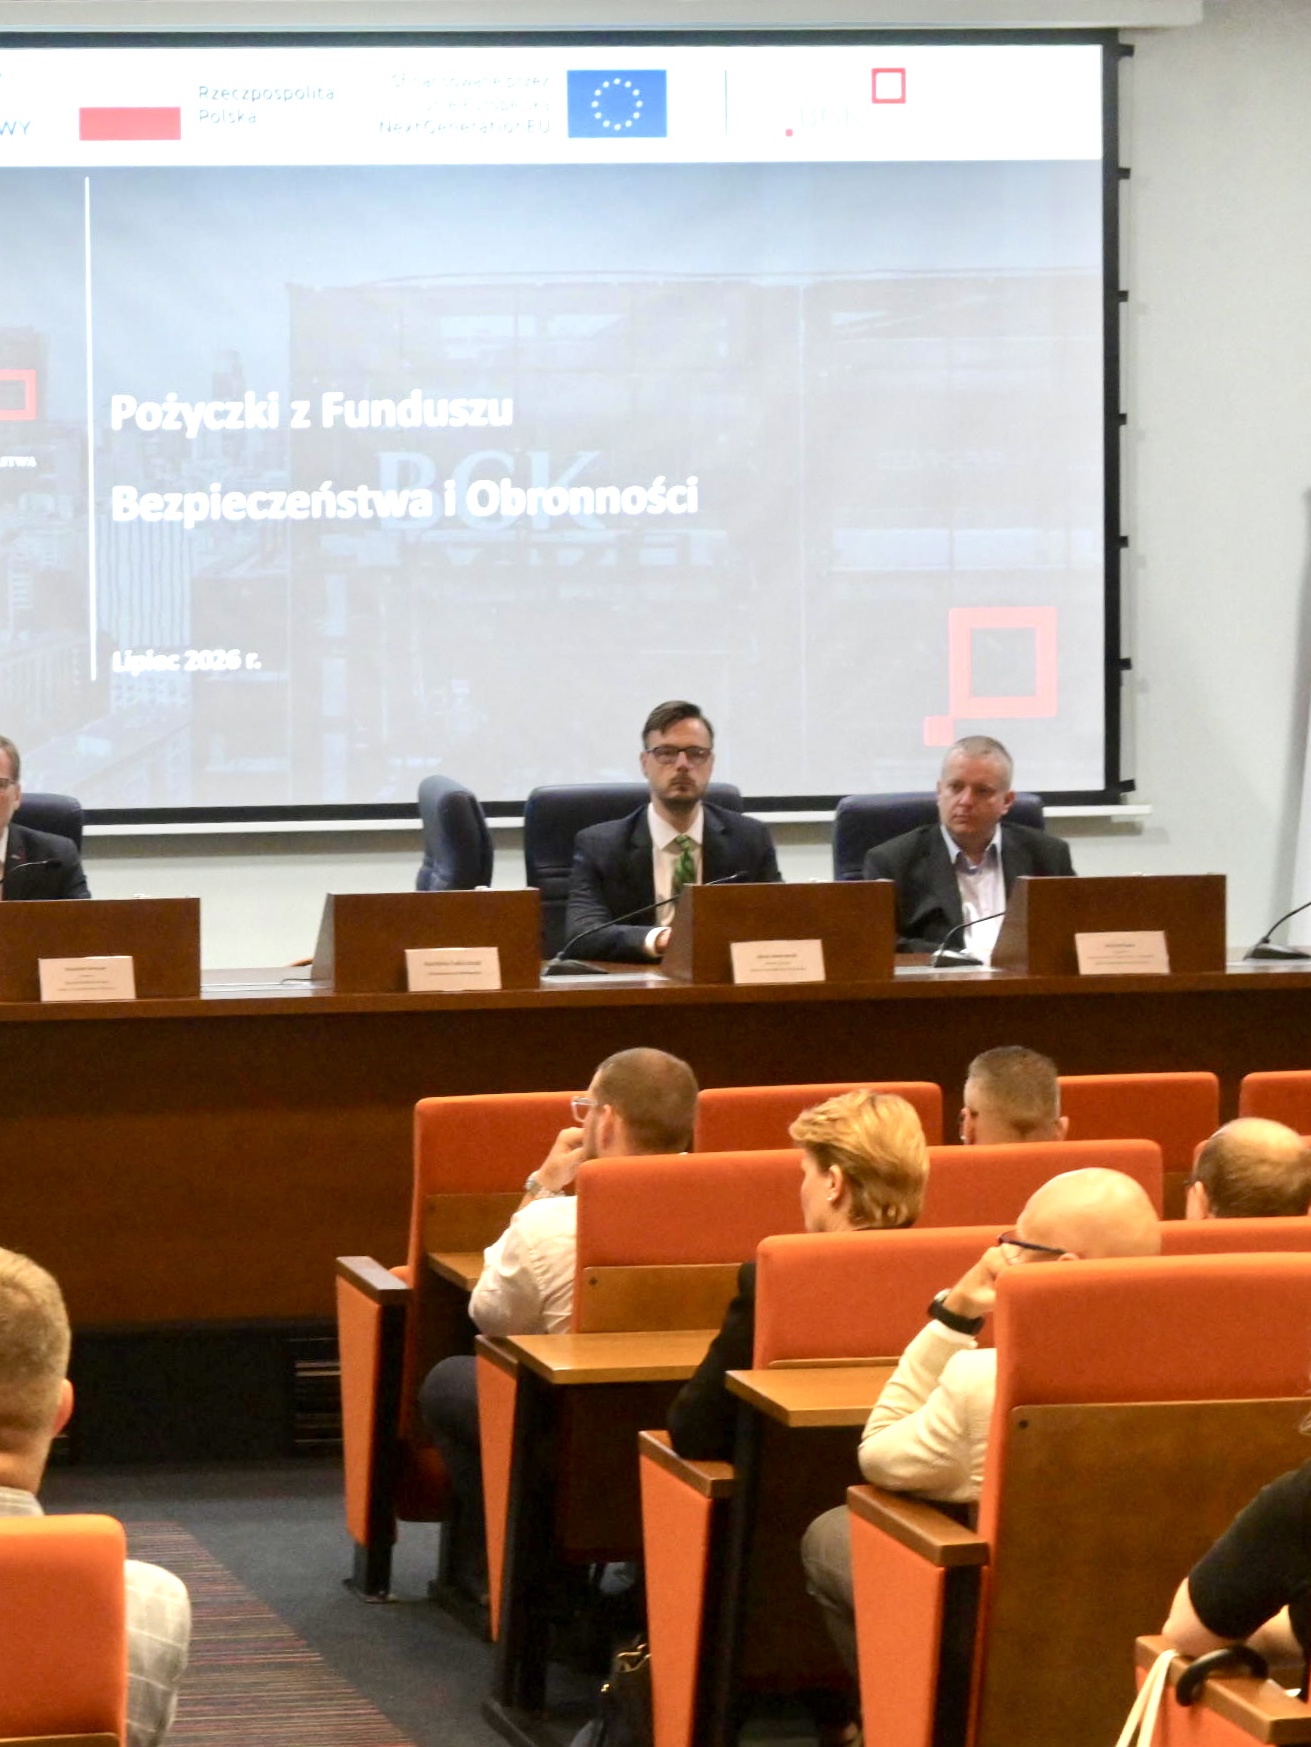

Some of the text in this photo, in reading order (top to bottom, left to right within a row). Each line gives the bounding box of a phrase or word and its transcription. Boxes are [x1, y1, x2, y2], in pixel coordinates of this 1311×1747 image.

[391, 73, 501, 88] Sfnansowane
[198, 85, 335, 102] Rzeczpospolita
[199, 108, 257, 124] Polska
[110, 389, 514, 439] Pożyczki z Funduszu
[110, 475, 700, 530] Bezpieczeństwa i Obronności
[111, 648, 263, 677] Lipiec 2026 r.
